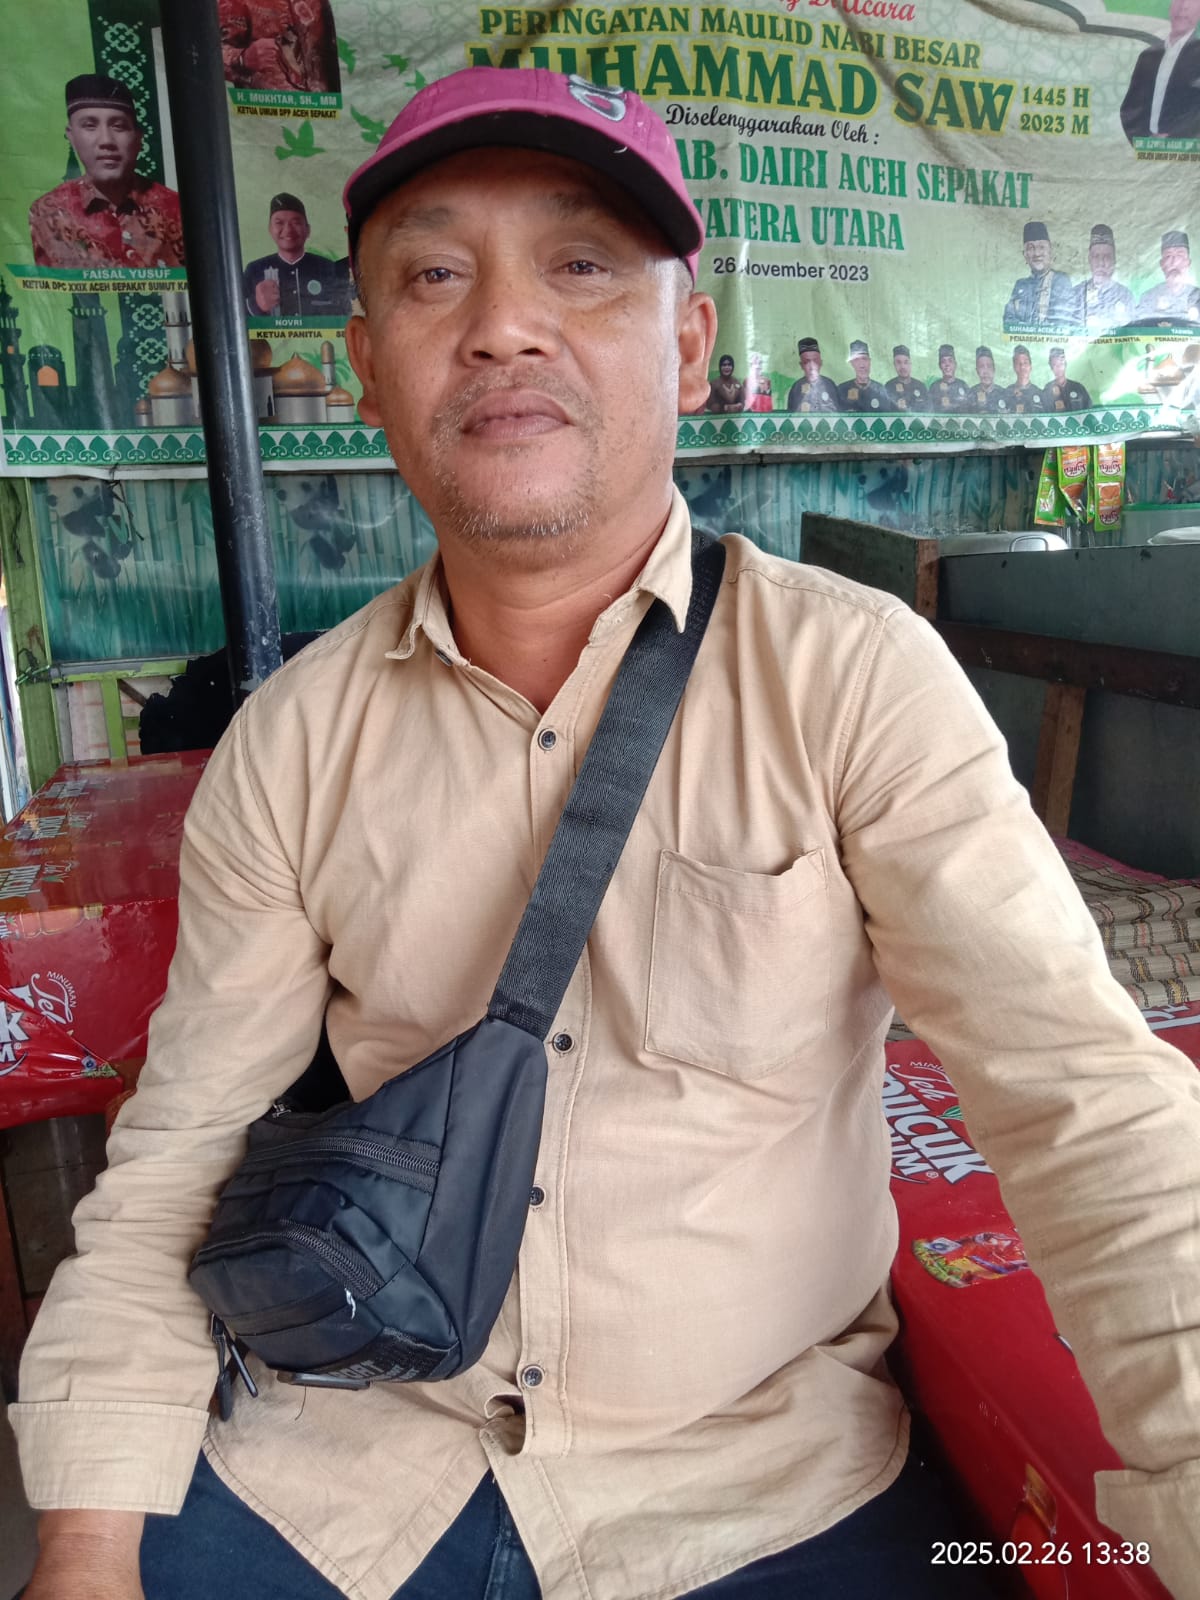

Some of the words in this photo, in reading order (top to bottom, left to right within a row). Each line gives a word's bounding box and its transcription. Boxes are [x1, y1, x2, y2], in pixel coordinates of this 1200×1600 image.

[480, 8, 690, 35] PERINGATAN
[701, 8, 813, 44] MAULID
[822, 24, 885, 59] NABI
[893, 36, 980, 69] BESAR
[249, 93, 297, 105] MUKHTAR,
[320, 96, 337, 105] MM
[895, 72, 1014, 131] SAW
[1022, 86, 1066, 106] 1445
[1073, 87, 1089, 108] H
[237, 106, 258, 115] KETUA
[665, 103, 826, 137] Diselenggarakan
[831, 120, 869, 143] Oleh
[1020, 114, 1065, 133] 2023
[1071, 115, 1089, 135] M
[674, 138, 729, 180] AB.
[739, 142, 828, 189] DAIRI
[839, 152, 907, 198] ACEH
[916, 162, 1033, 208] SEPAKAT
[811, 206, 904, 250] UTARA
[82, 269, 127, 279] FAISAL
[129, 268, 172, 279] YUSUF
[713, 257, 736, 274] 26
[829, 264, 869, 281] 2023
[22, 279, 50, 290] KETUA
[52, 281, 67, 291] DPC
[89, 282, 110, 291] ACEH
[112, 281, 146, 291] SEPAKAT
[148, 281, 176, 291] SUMUT
[256, 330, 287, 339] KETUA
[288, 330, 322, 339] PANITIA
[275, 319, 302, 327] NOVRI
[46, 971, 77, 1008] MINUMAN
[889, 1063, 959, 1102] Teh
